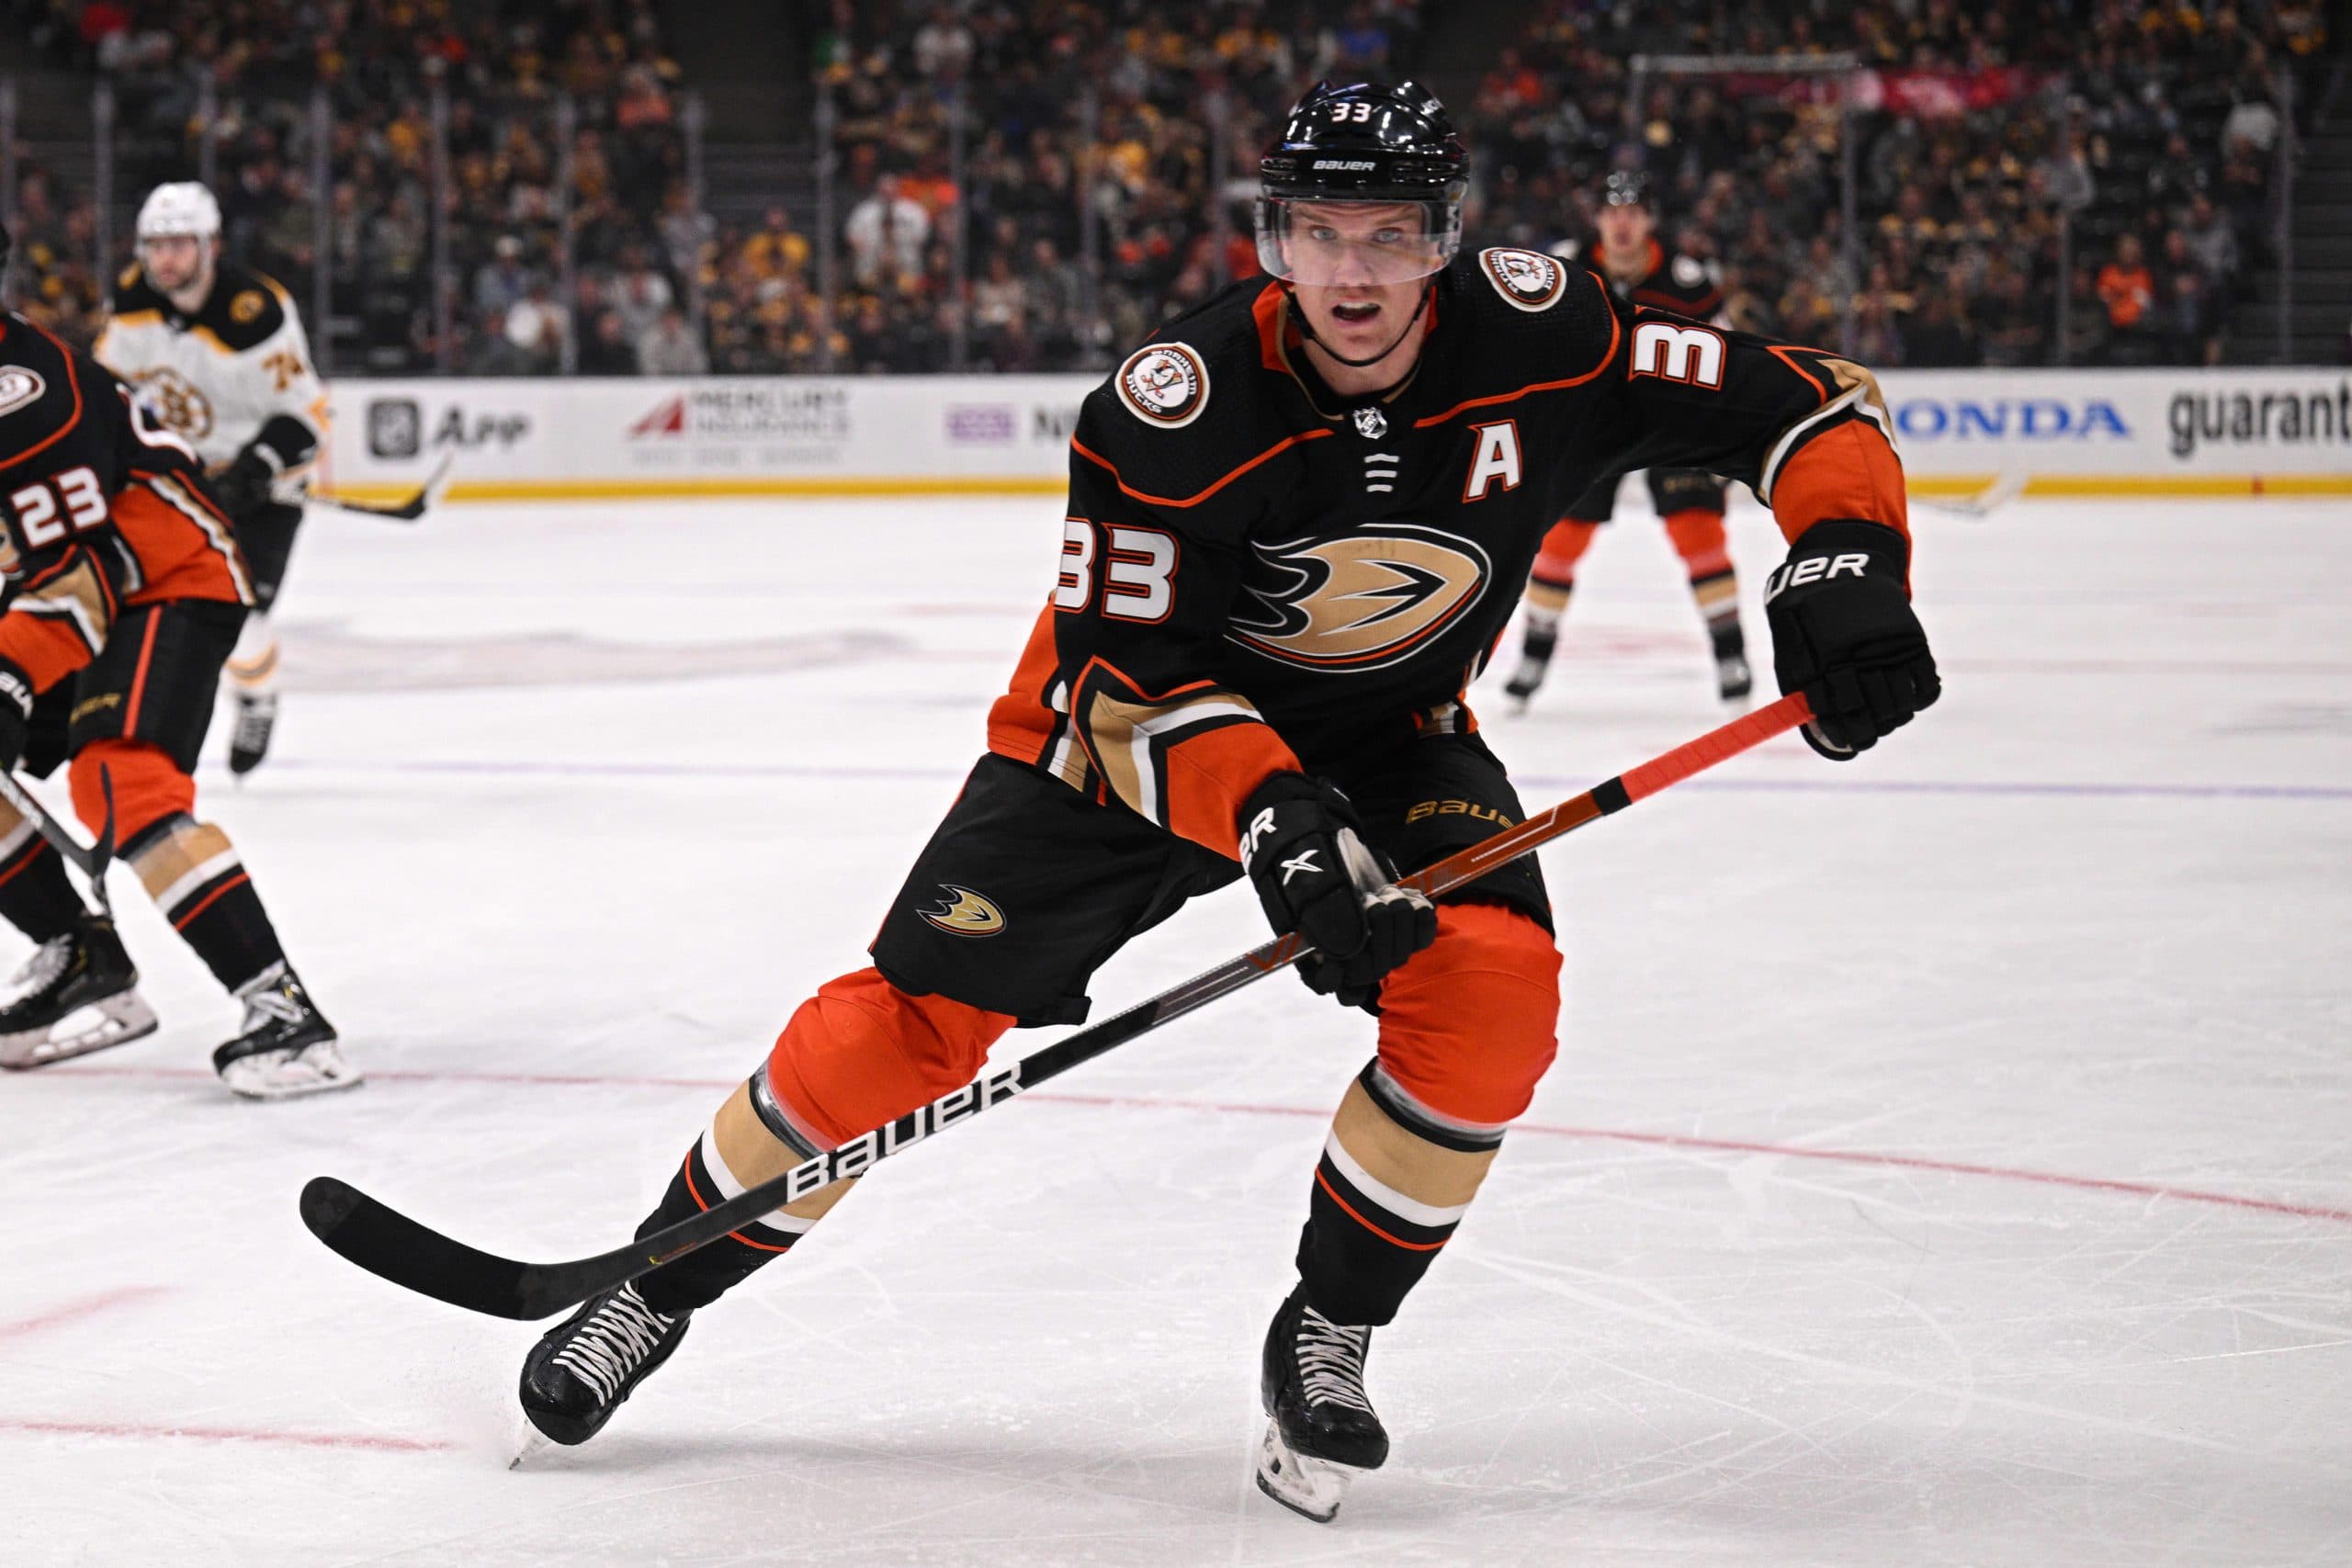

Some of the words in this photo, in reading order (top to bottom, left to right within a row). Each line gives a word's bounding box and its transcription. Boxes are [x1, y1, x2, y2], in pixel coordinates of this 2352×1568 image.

[1331, 102, 1372, 123] 33
[1312, 160, 1376, 172] BAUER
[1463, 419, 1523, 503] A
[9, 465, 110, 551] 23
[1054, 516, 1181, 625] 33
[786, 1061, 1025, 1202] BAUER
